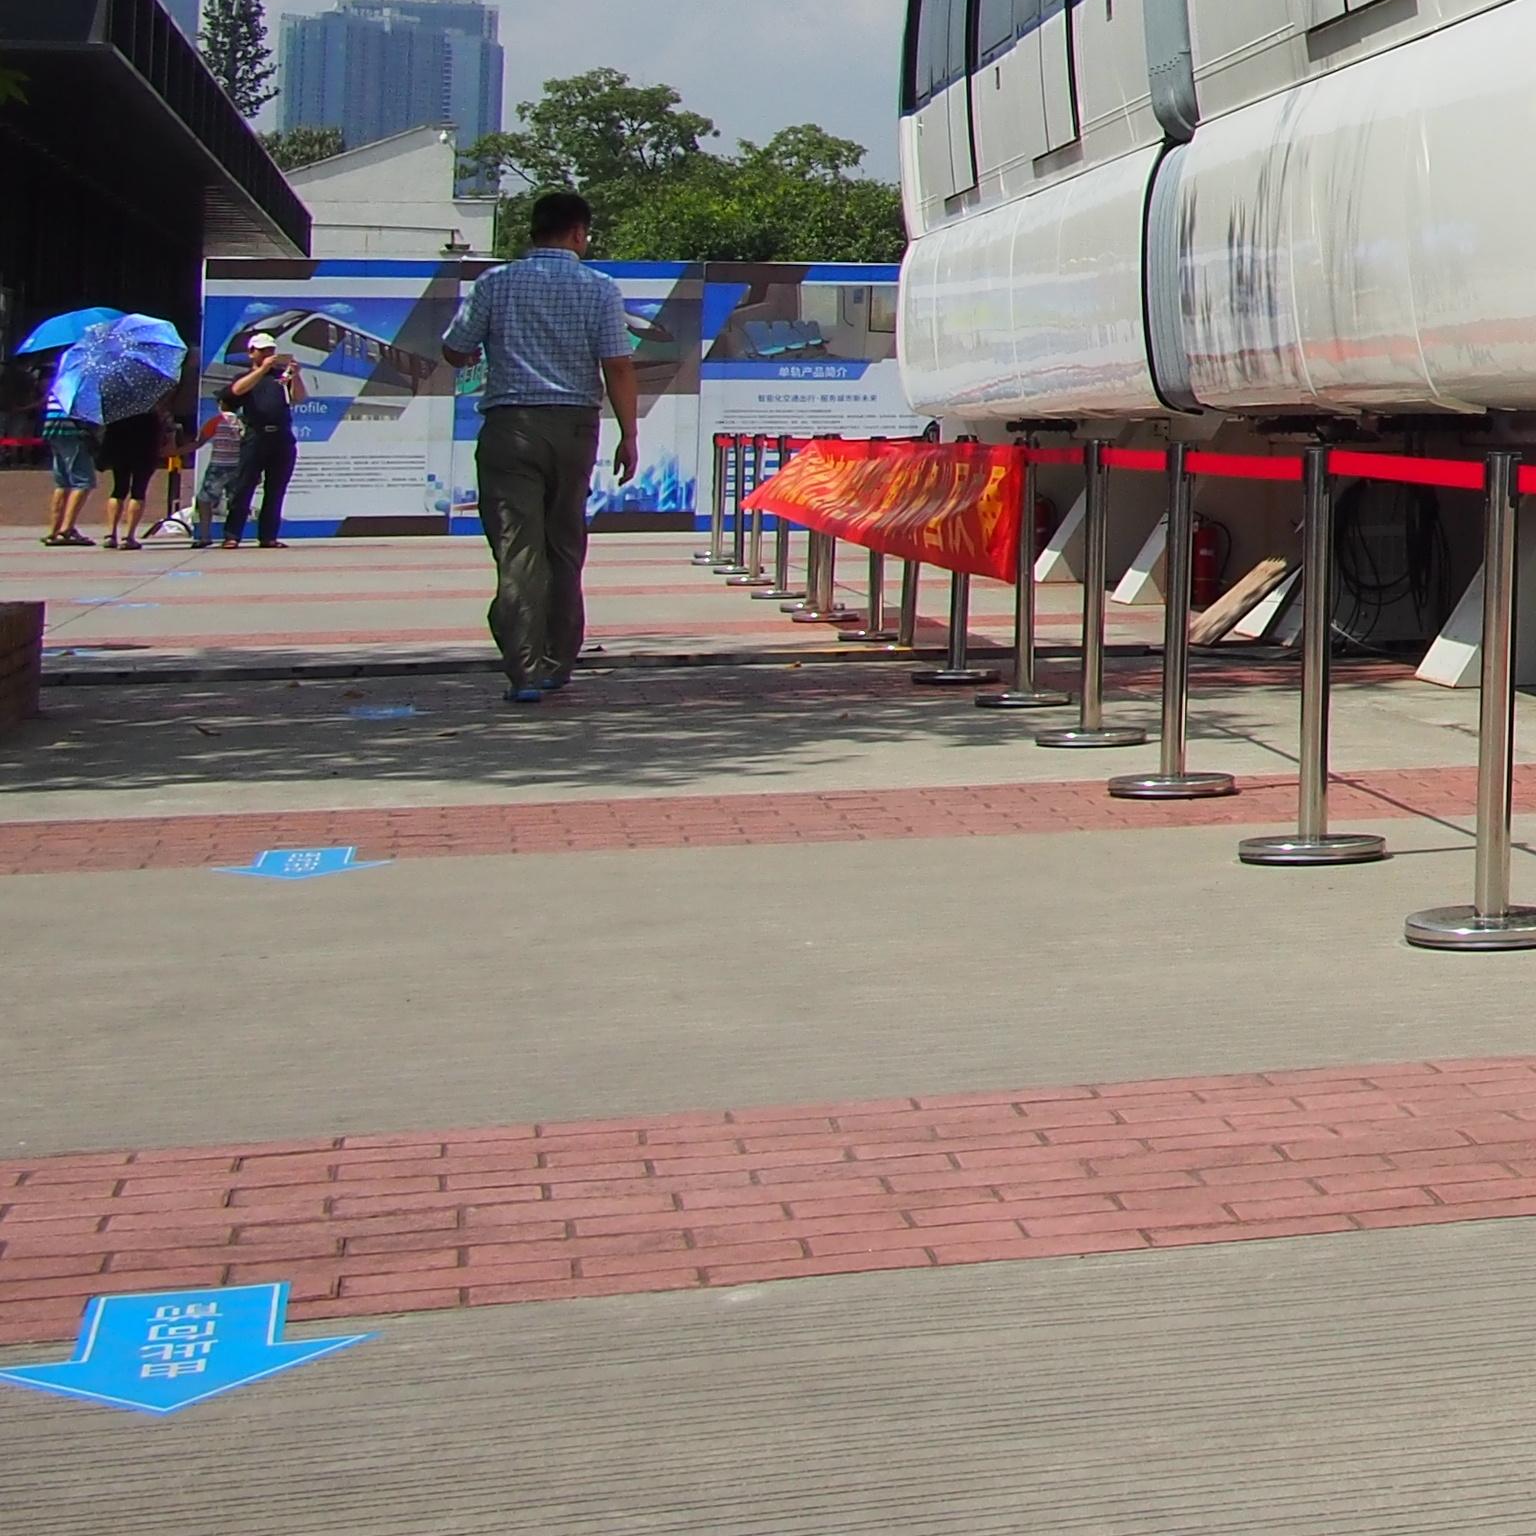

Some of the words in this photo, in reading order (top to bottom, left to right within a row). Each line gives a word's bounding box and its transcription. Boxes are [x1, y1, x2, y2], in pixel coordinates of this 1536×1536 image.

[778, 366, 848, 378] 单轨产品简介
[290, 401, 328, 414] rofile
[138, 1301, 224, 1379] 由此向前
